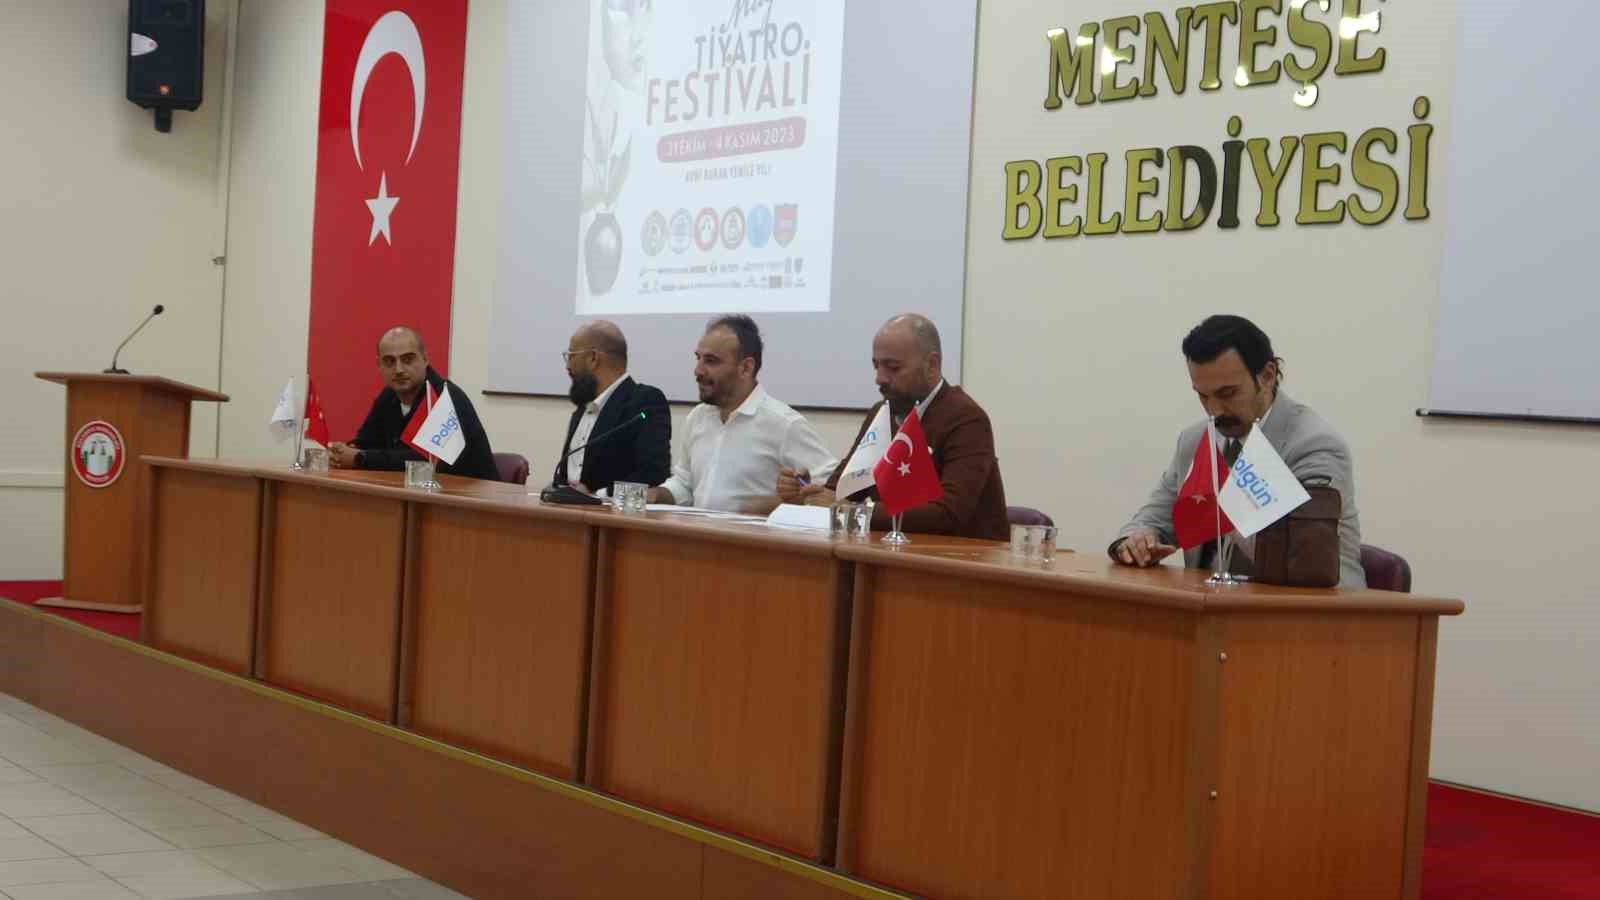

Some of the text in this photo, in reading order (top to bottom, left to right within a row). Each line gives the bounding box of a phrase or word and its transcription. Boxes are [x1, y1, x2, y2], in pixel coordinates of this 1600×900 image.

[646, 38, 811, 127] FESTİVALİ
[694, 21, 804, 72] TİYATRO
[1043, 0, 1387, 109] MENTEŞE
[762, 125, 795, 146] 2023
[1002, 95, 1434, 241] BELEDİYESİ
[1233, 452, 1273, 507] olgün
